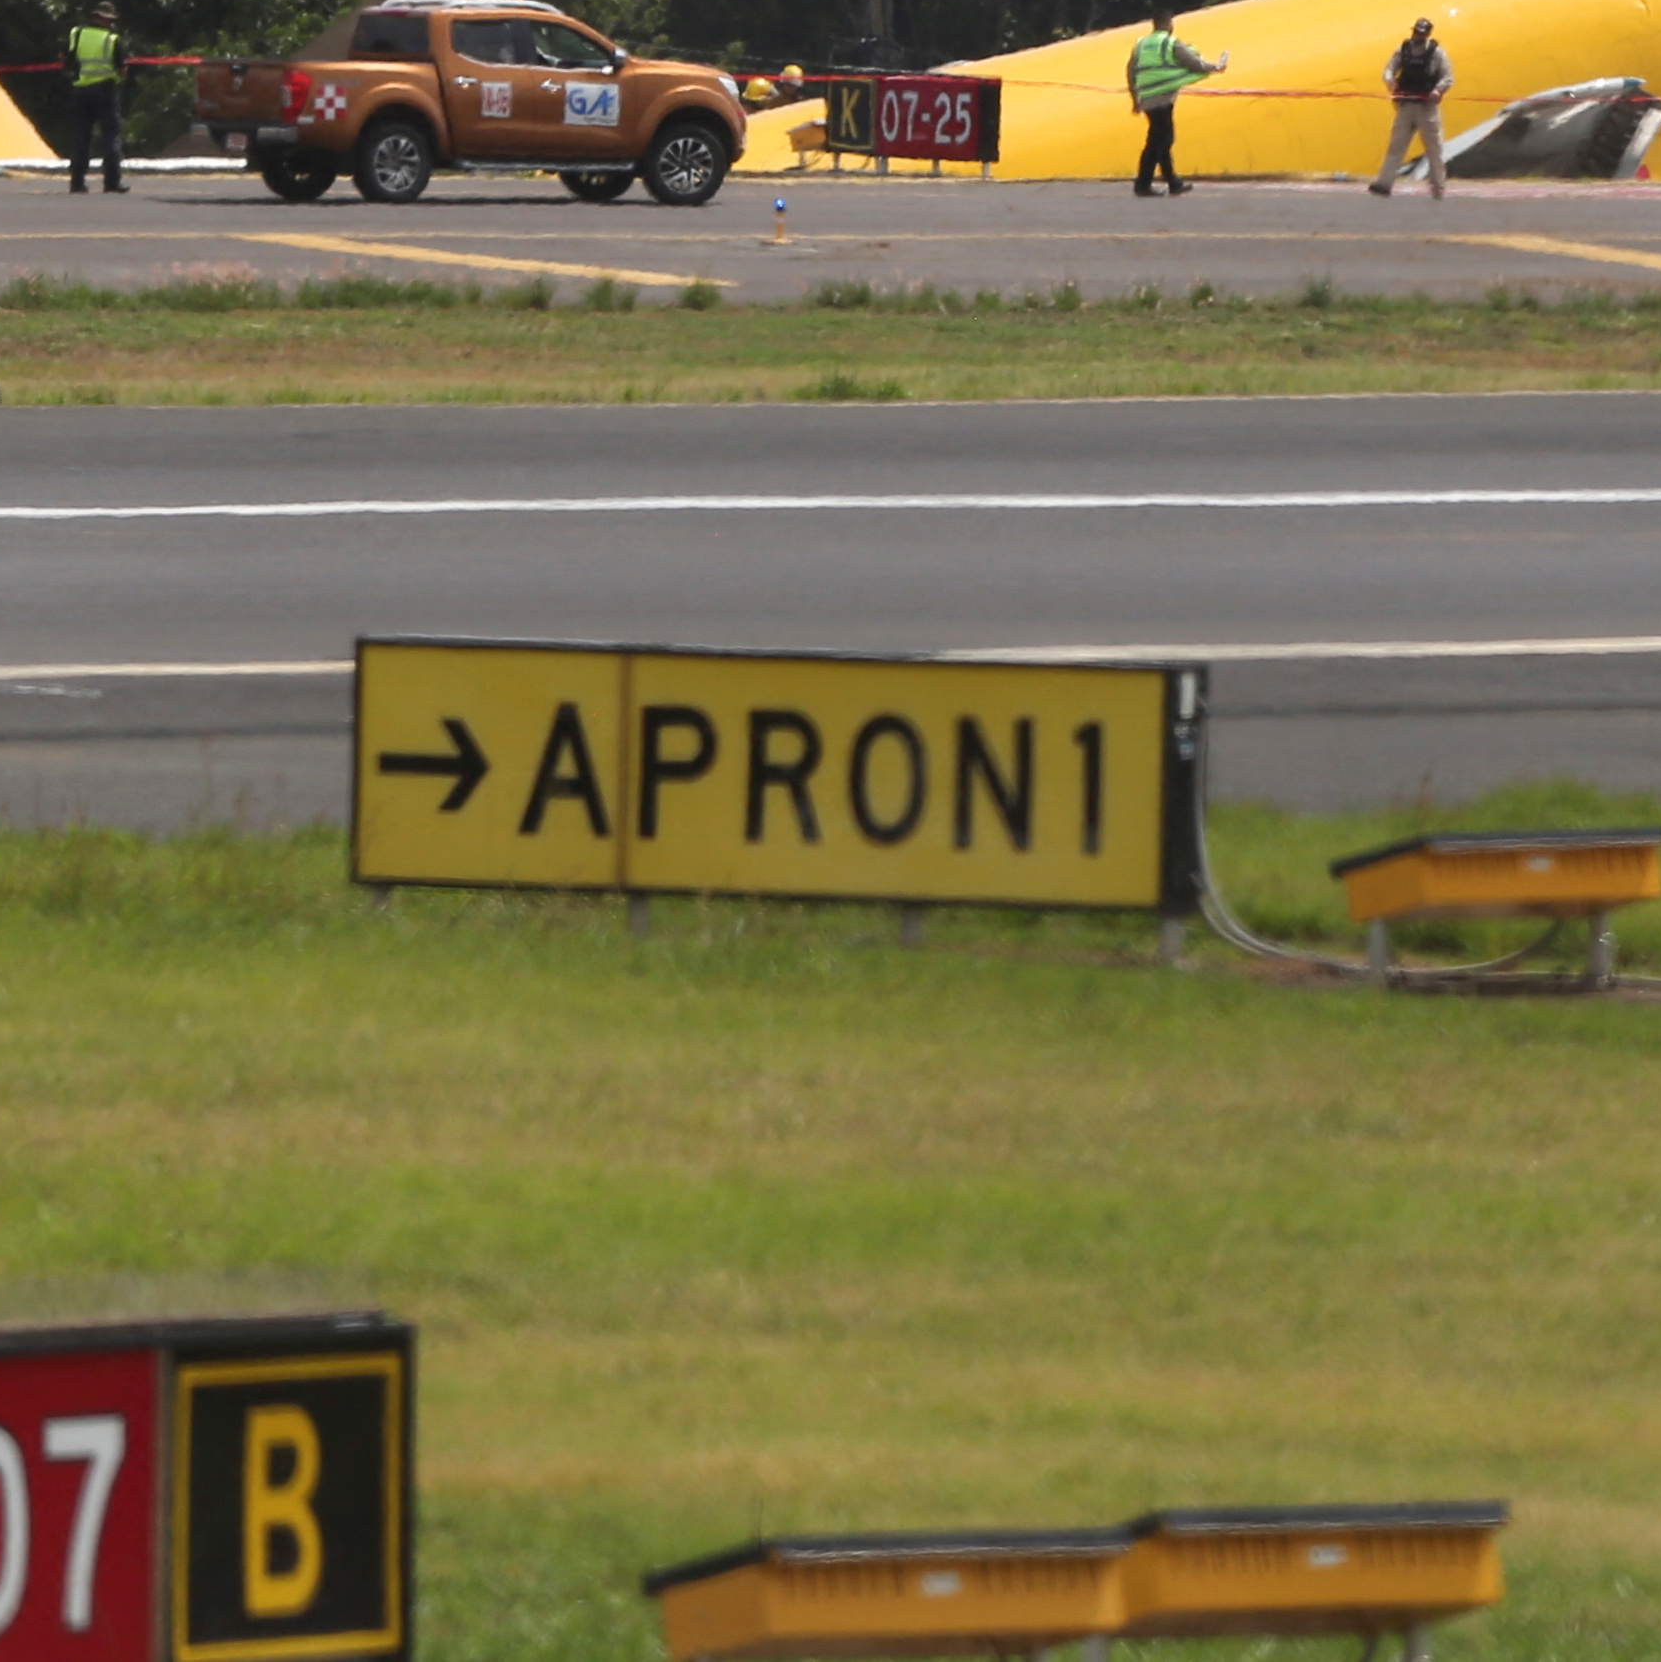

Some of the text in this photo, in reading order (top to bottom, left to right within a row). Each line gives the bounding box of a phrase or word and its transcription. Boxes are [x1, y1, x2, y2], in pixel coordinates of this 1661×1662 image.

[841, 88, 972, 144] K 07-25
[242, 1402, 324, 1619] B
